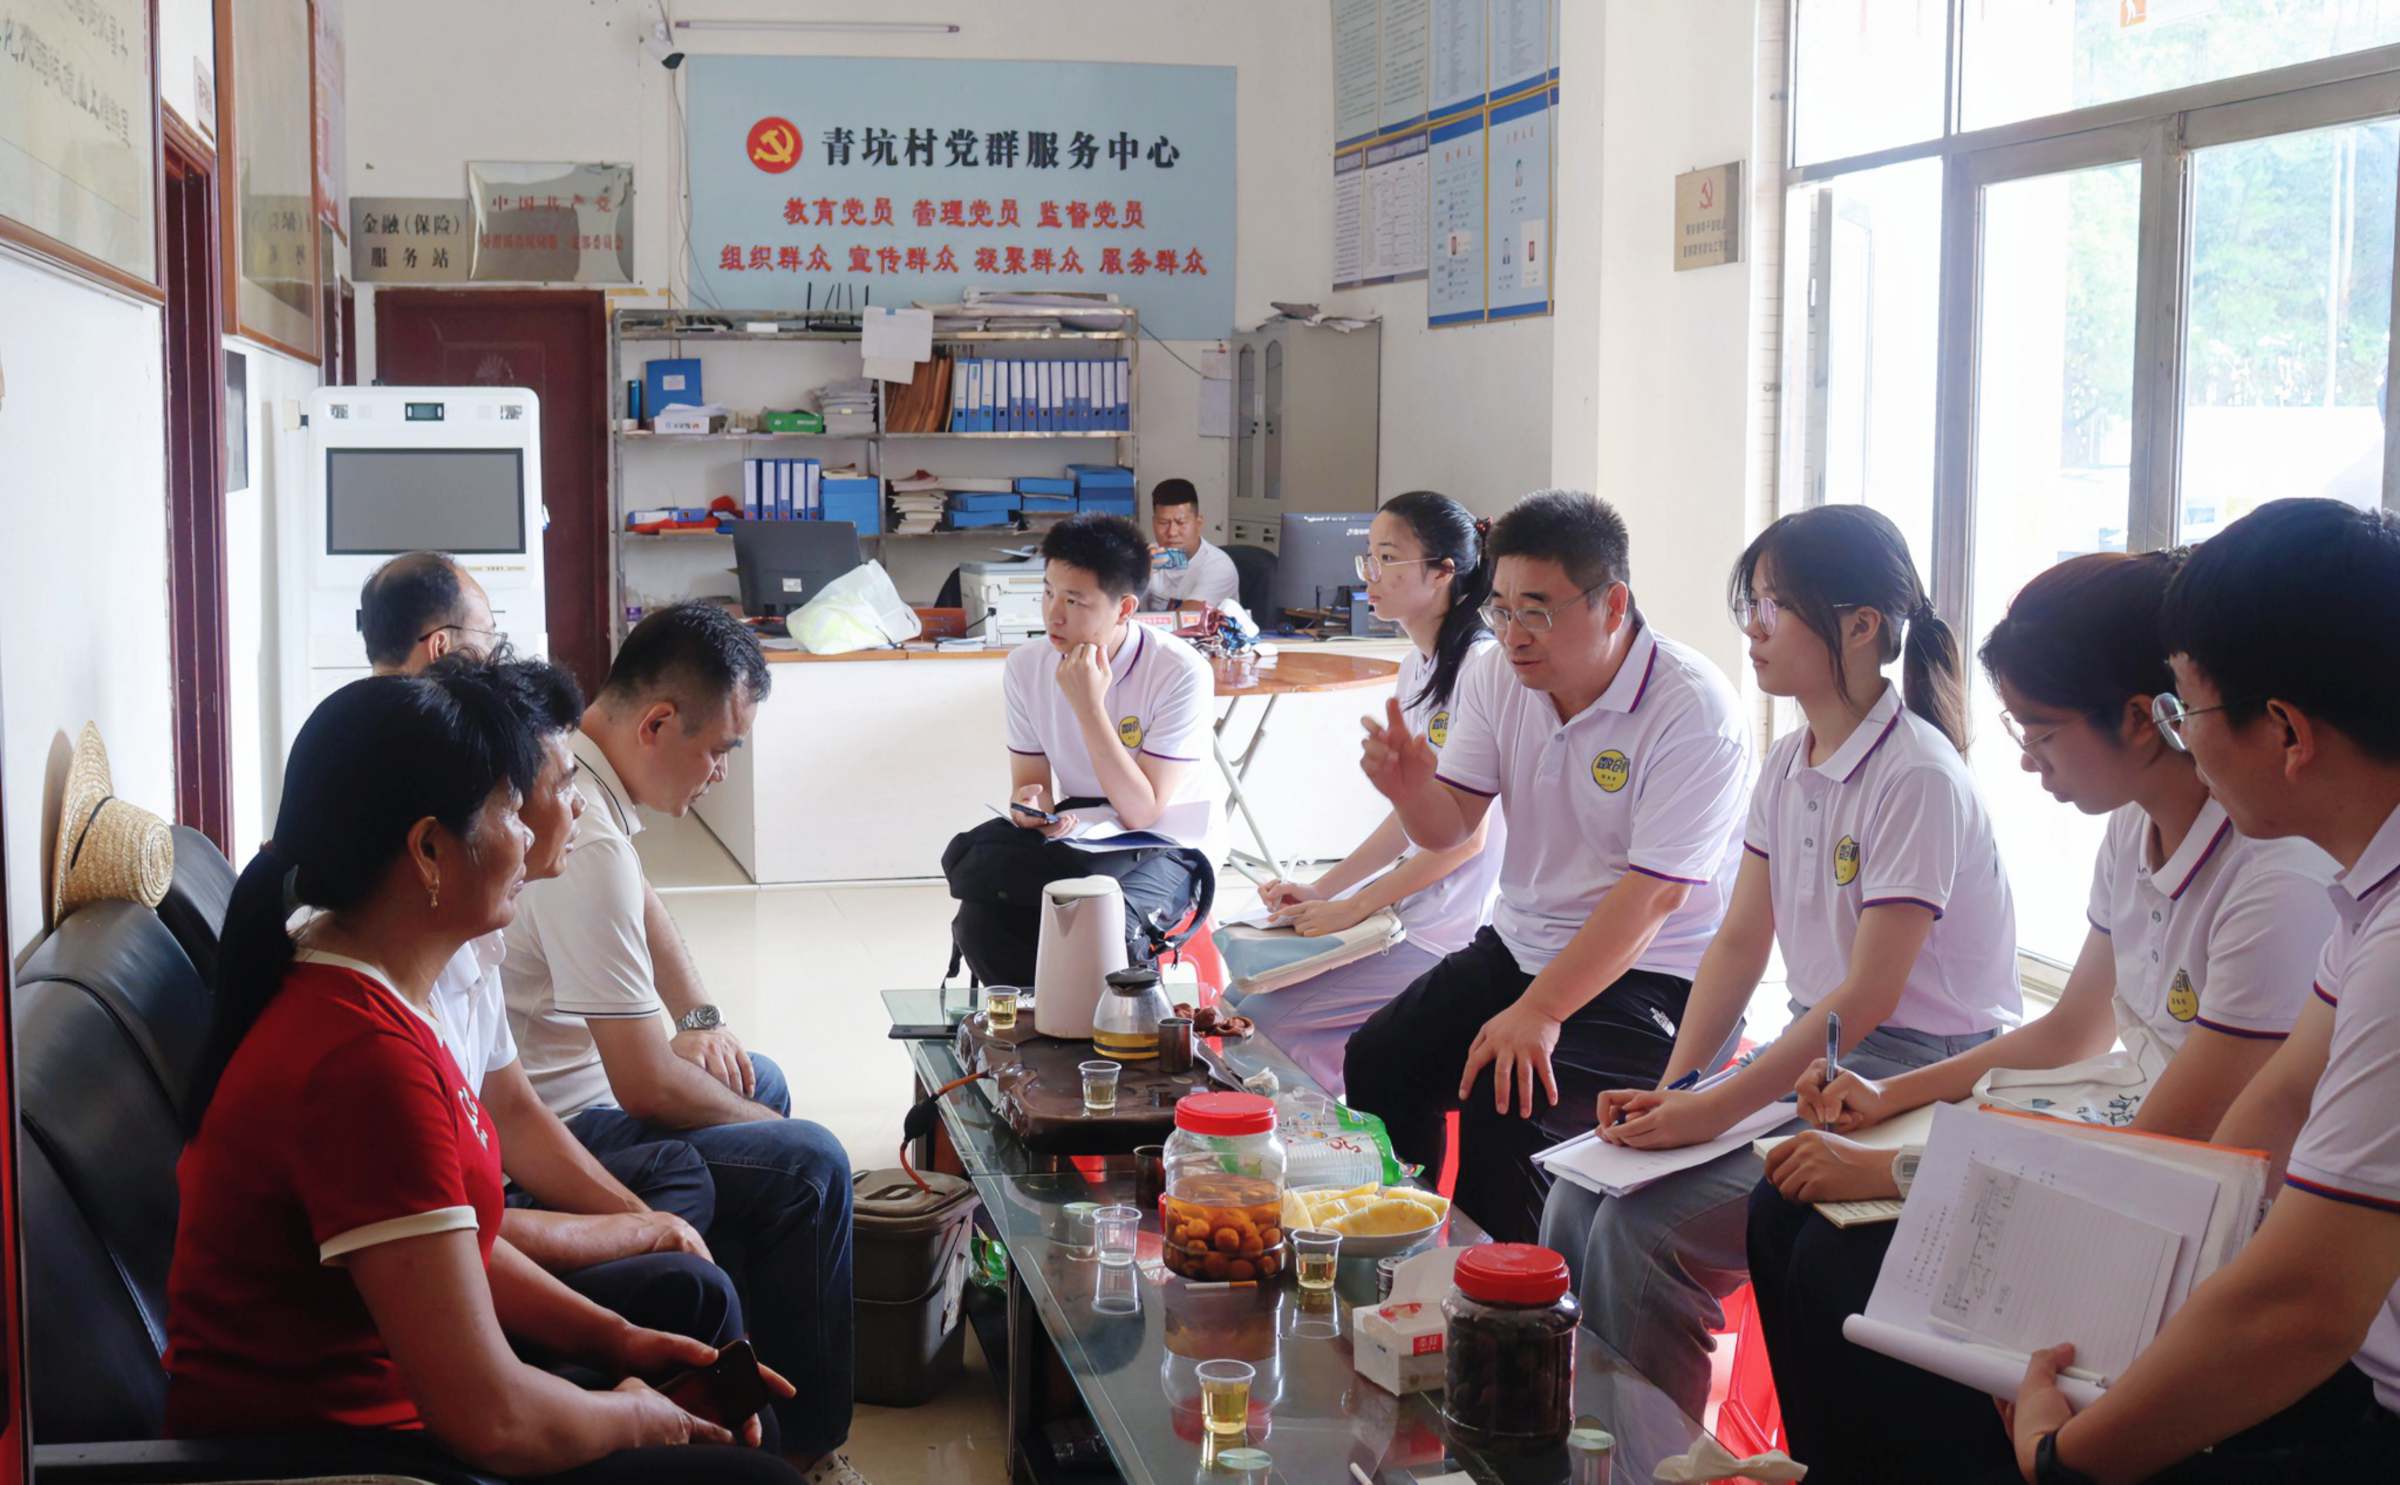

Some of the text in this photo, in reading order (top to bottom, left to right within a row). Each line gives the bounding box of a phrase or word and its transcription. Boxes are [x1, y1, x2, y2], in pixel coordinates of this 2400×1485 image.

[822, 126, 1181, 171] 青坑村党群服务中心
[784, 197, 1144, 229] 教育党员 管理党员 监督党员
[371, 247, 449, 268] 服务站
[719, 244, 1207, 275] 组织群众 宣传群众 凝聚群众 服务群众
